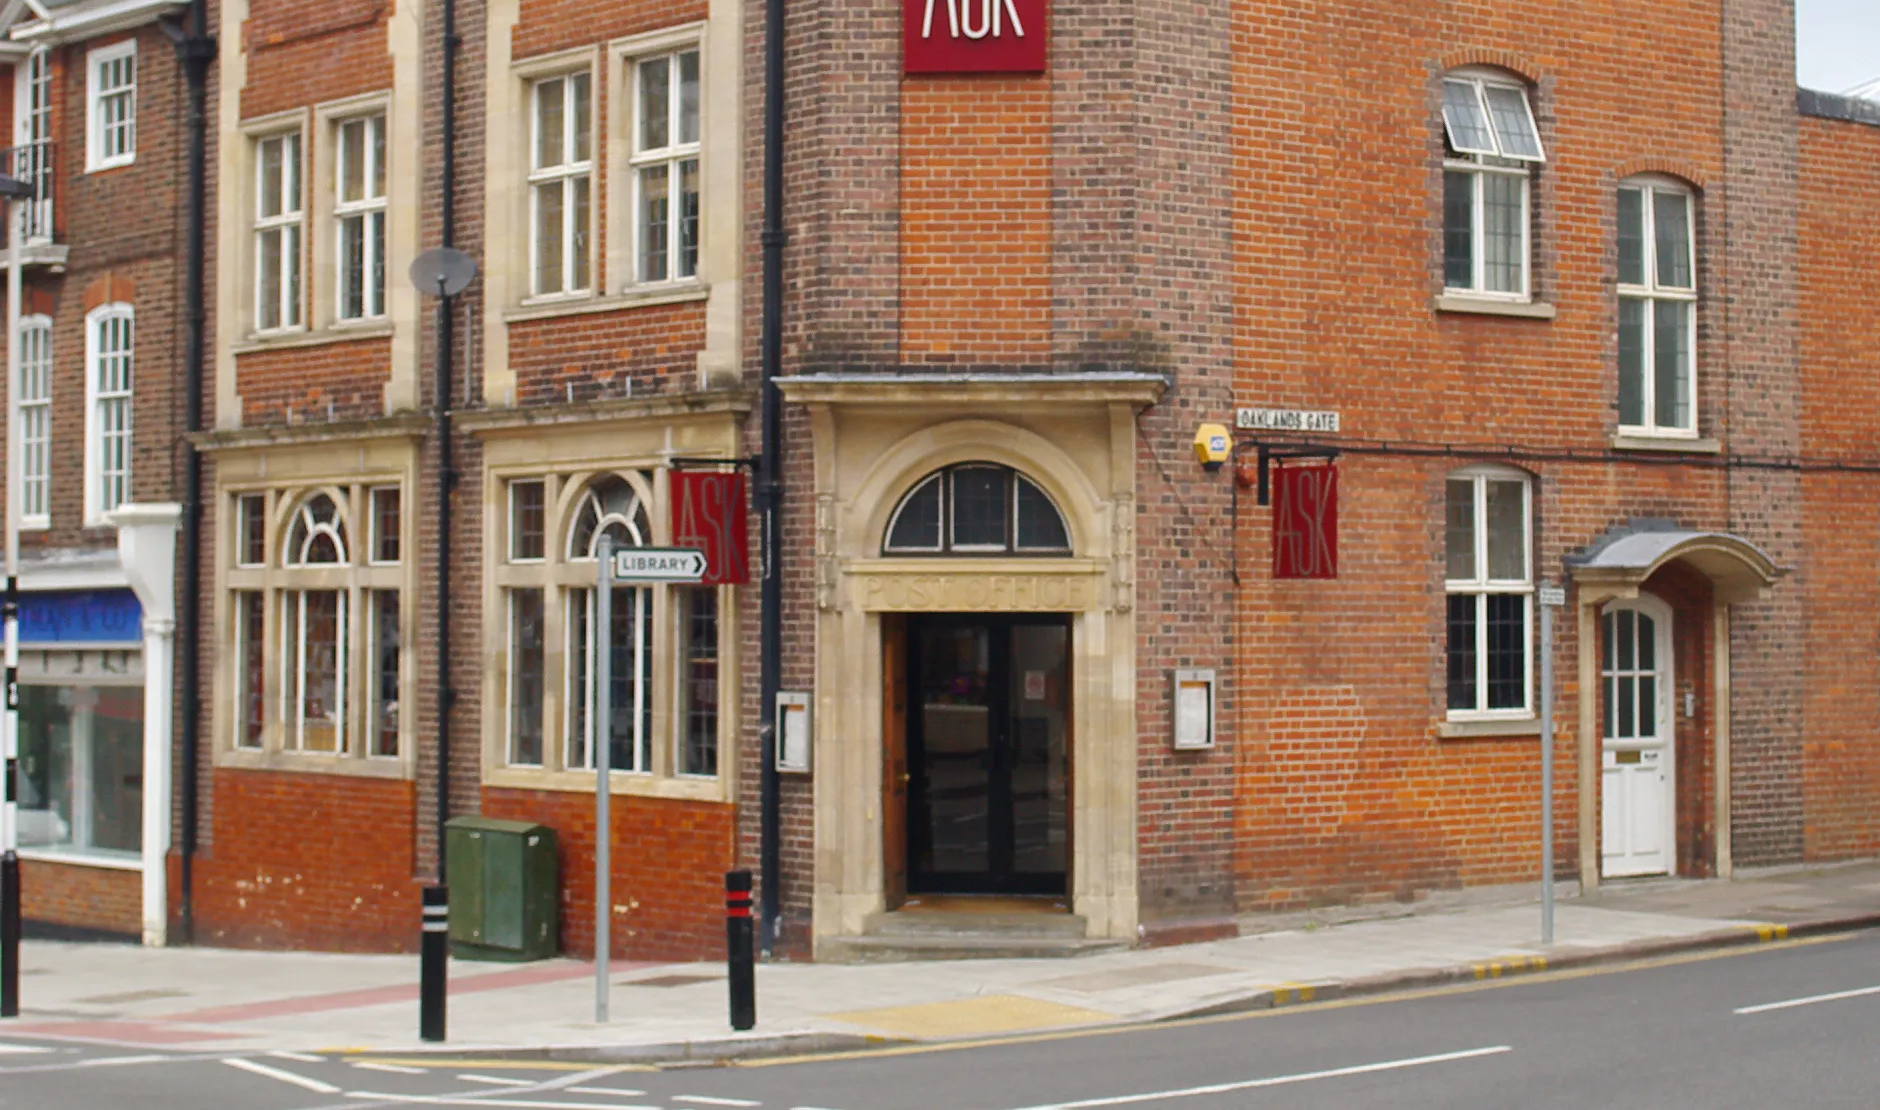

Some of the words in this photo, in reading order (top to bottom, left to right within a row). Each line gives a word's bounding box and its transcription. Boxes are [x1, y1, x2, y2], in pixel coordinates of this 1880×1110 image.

[1241, 410, 1301, 430] OAKLANDS
[1306, 412, 1336, 431] GATE
[677, 476, 745, 580] ASK
[1275, 470, 1336, 576] ASK
[622, 557, 688, 570] LIBRARY
[861, 576, 958, 609] POST
[963, 576, 1088, 609] OFFICE
